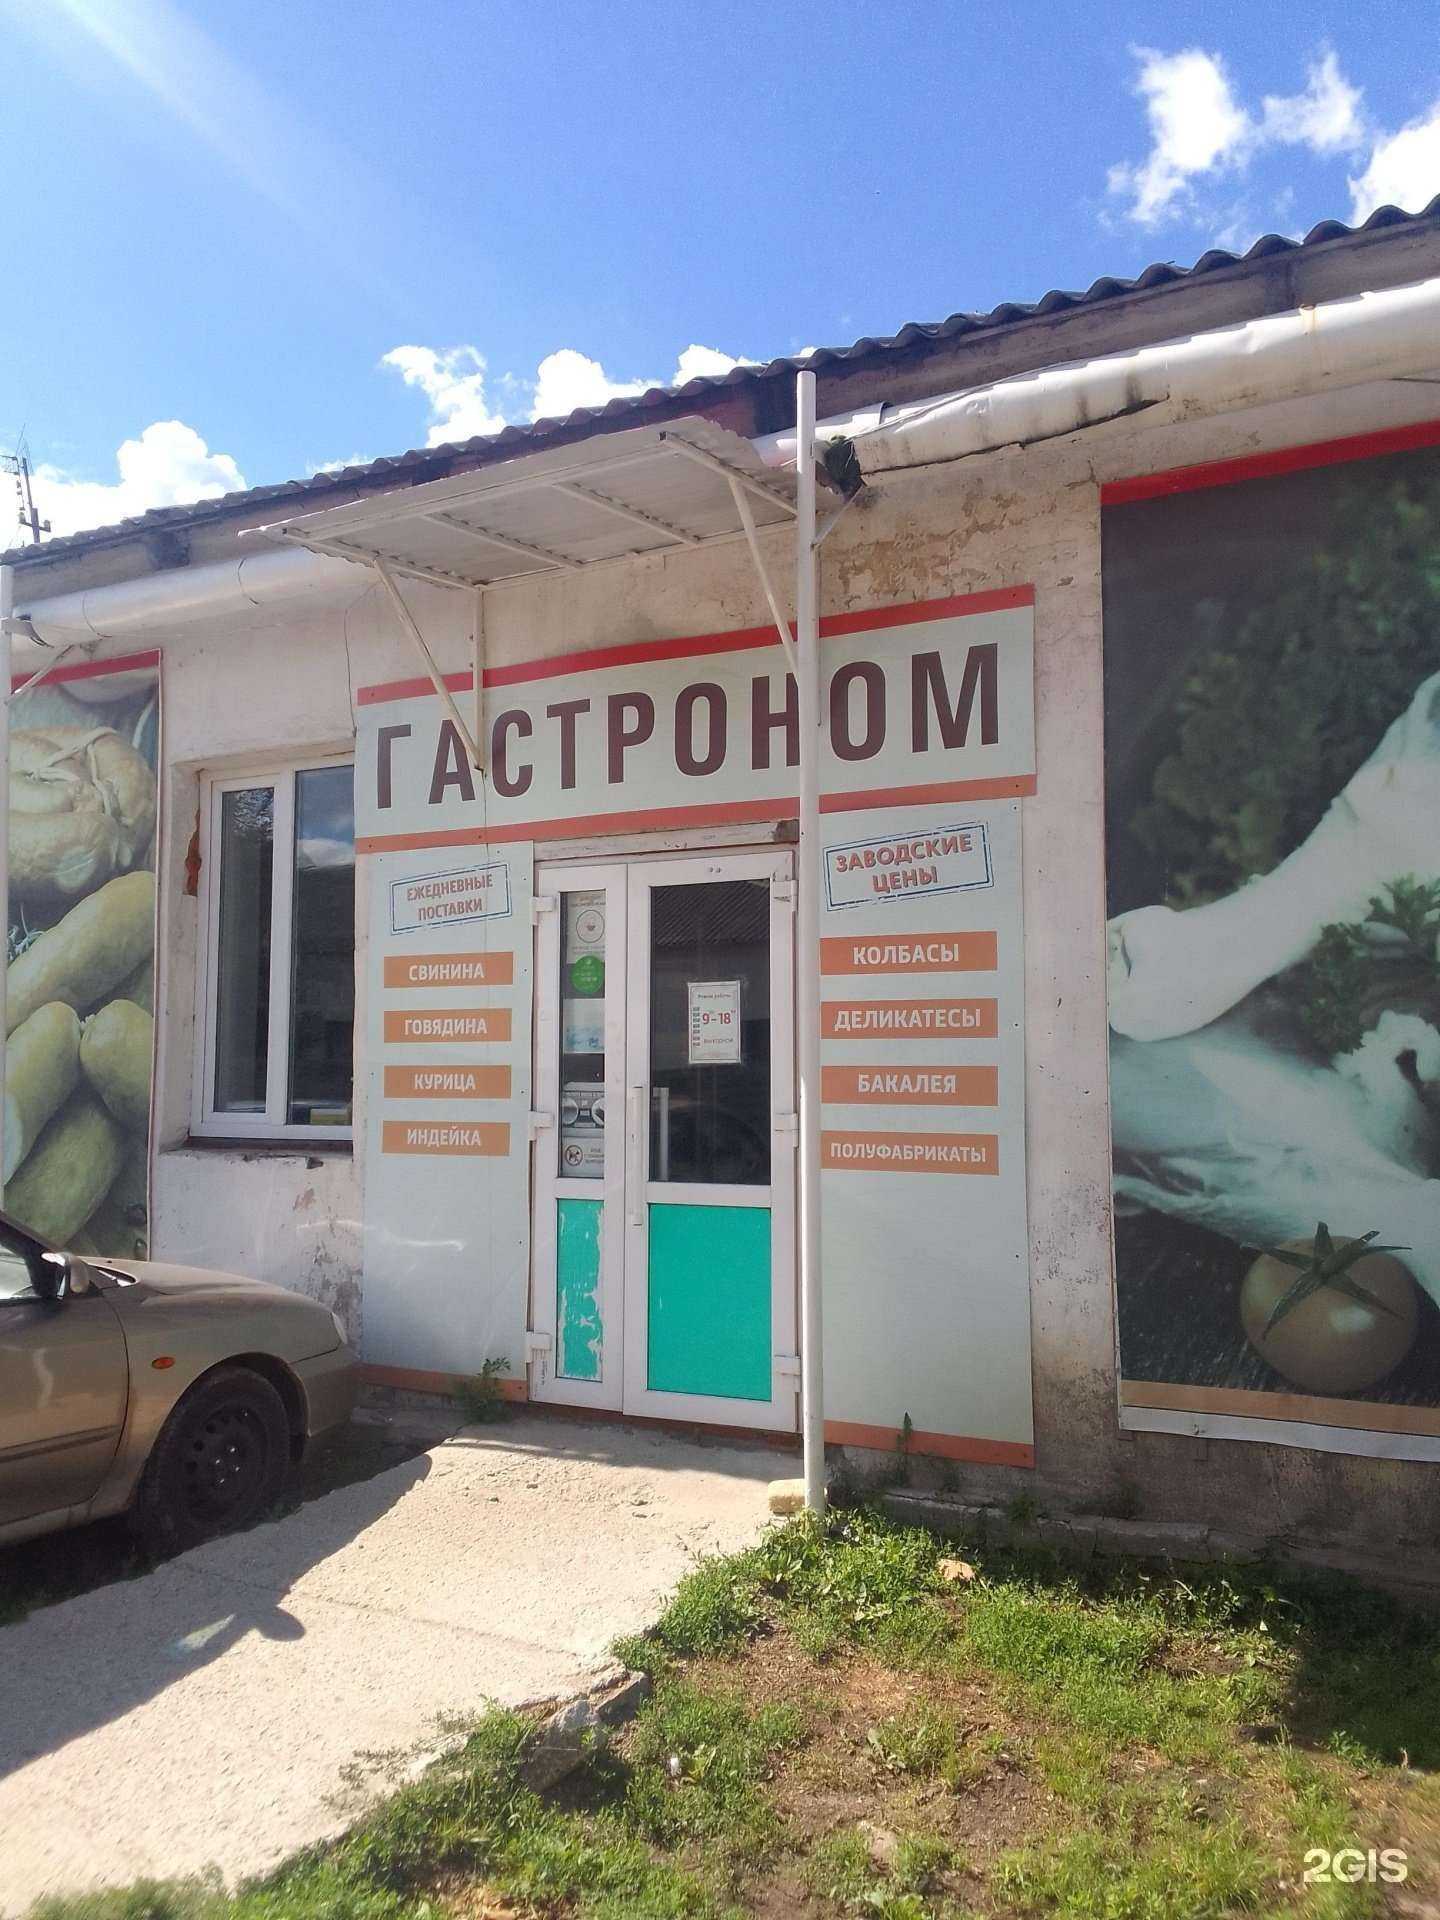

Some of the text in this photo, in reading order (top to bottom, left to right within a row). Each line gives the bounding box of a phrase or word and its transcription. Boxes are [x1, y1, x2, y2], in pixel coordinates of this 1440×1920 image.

[377, 642, 999, 809] ГАСТРОНОМ
[835, 833, 973, 873] ЗАВОДСКИЕ
[407, 874, 494, 901] ЕЖЕДНЕВНЫЕ
[872, 866, 938, 894] ЦЕНЫ
[418, 898, 483, 921] ПОСТАВКИ
[852, 943, 960, 966] КОЛБАСЫ
[408, 963, 485, 982] СВИНИНА
[404, 1016, 488, 1036] ГОВЯДИНА
[834, 1008, 982, 1032] ДЕЛИКАТЕСЫ
[414, 1073, 476, 1092] КУРИЦА
[857, 1072, 957, 1095] БАКАЛЕЯ
[407, 1126, 482, 1148] ИНДЕЙКА
[830, 1142, 986, 1164] ПОЛУФАБРИКАТЫ
